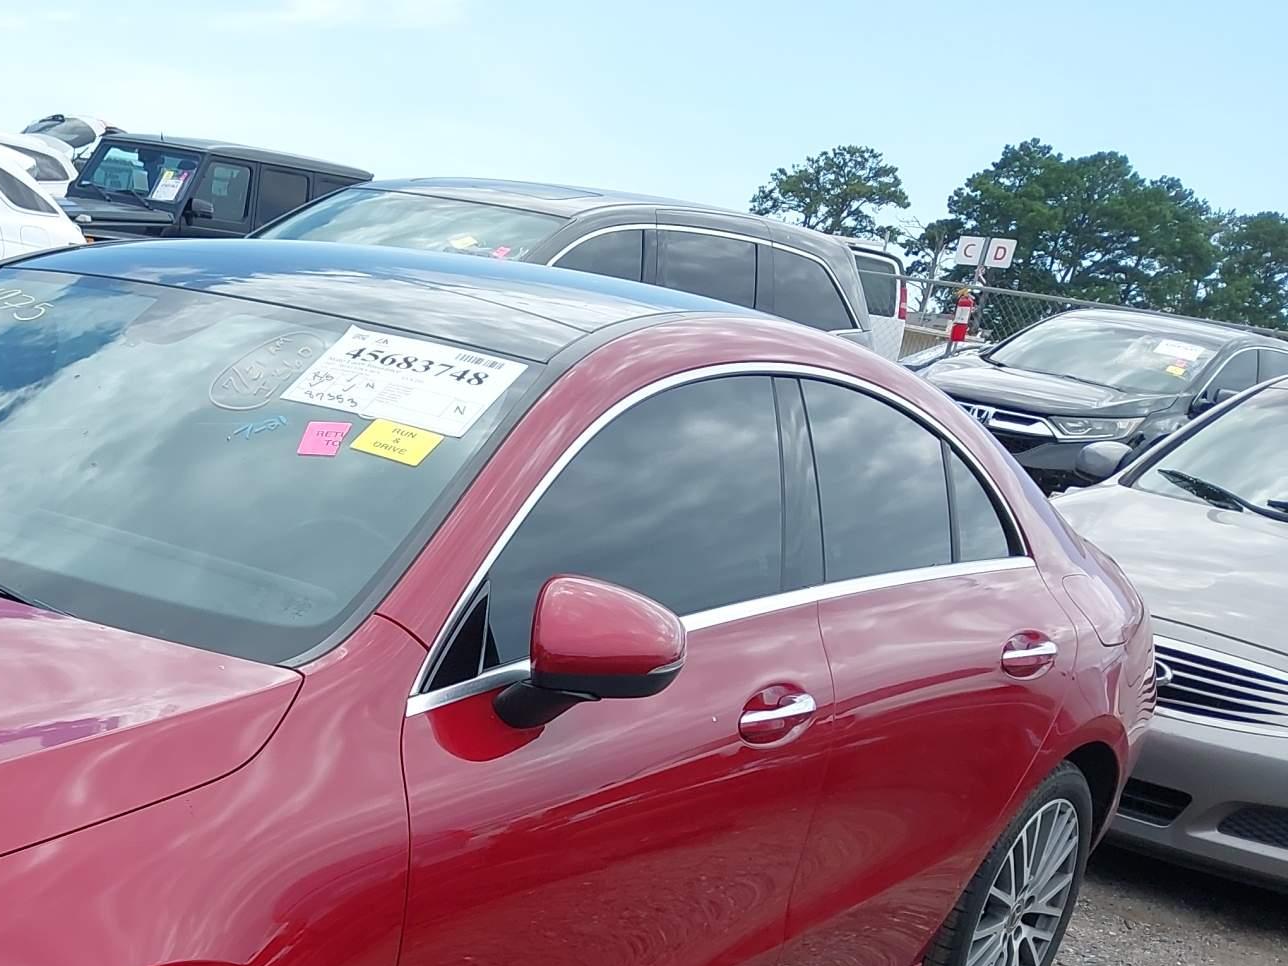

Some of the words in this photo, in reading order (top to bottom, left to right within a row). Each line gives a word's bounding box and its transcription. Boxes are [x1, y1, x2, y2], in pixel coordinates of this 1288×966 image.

[963, 243, 977, 258] C
[993, 246, 1008, 261] D
[345, 347, 489, 386] 45683748
[392, 427, 418, 439] RUN
[372, 440, 409, 456] DRIVE
